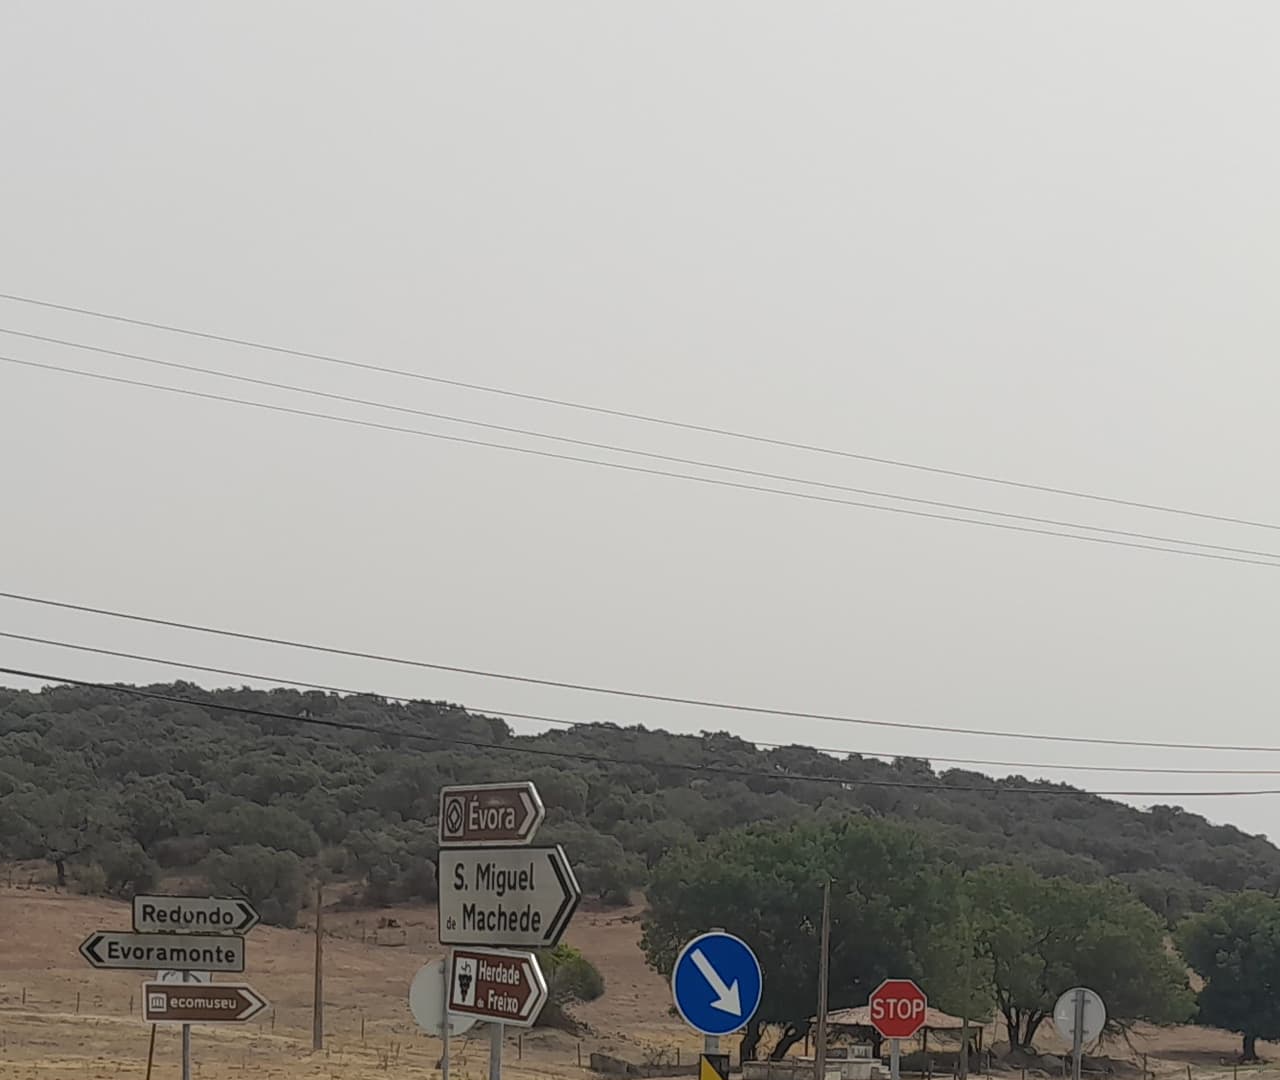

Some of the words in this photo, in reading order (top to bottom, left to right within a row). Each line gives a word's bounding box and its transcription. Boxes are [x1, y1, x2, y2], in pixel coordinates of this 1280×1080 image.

[468, 794, 516, 831] Évora
[453, 862, 468, 891] S.
[475, 861, 535, 897] Miguel
[142, 904, 234, 925] Redondo
[446, 916, 456, 930] de
[463, 903, 541, 932] Machede
[108, 942, 235, 962] Evoramonte
[479, 960, 520, 985] Herdade
[170, 998, 237, 1009] ecomuseu
[487, 989, 519, 1014] Freixo
[872, 998, 924, 1019] STOP
